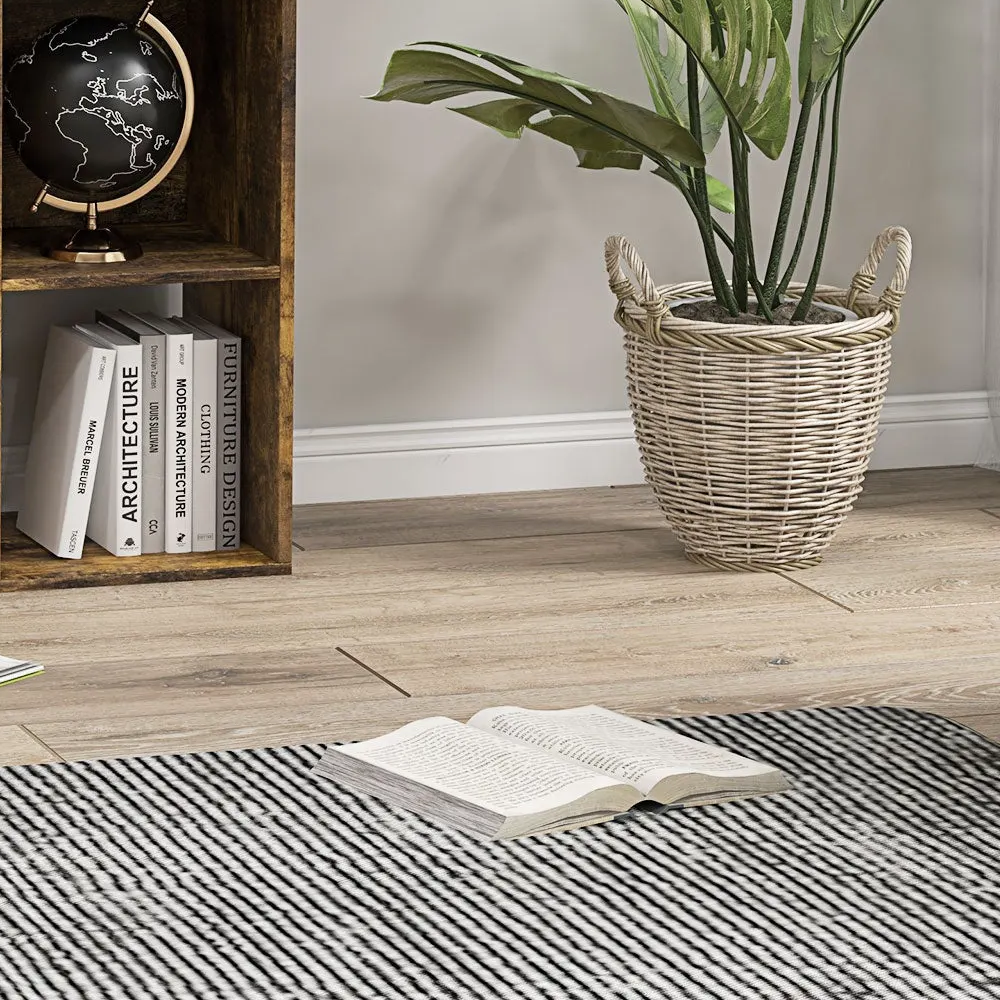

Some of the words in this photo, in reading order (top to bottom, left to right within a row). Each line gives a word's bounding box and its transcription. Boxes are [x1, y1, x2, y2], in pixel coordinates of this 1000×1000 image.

[148, 402, 159, 421] LOUIS
[175, 378, 187, 428] MODERN
[222, 342, 238, 465] FURNITURE
[83, 420, 97, 456] MARCEL
[121, 366, 139, 522] ARCHITECTURE
[148, 422, 159, 453] SULLIVAN
[200, 404, 211, 474] CLOTHING
[77, 459, 91, 494] BREUER
[175, 431, 186, 518] ARCHITECTURE
[149, 519, 158, 535] CCA
[222, 472, 236, 548] DESIGN
